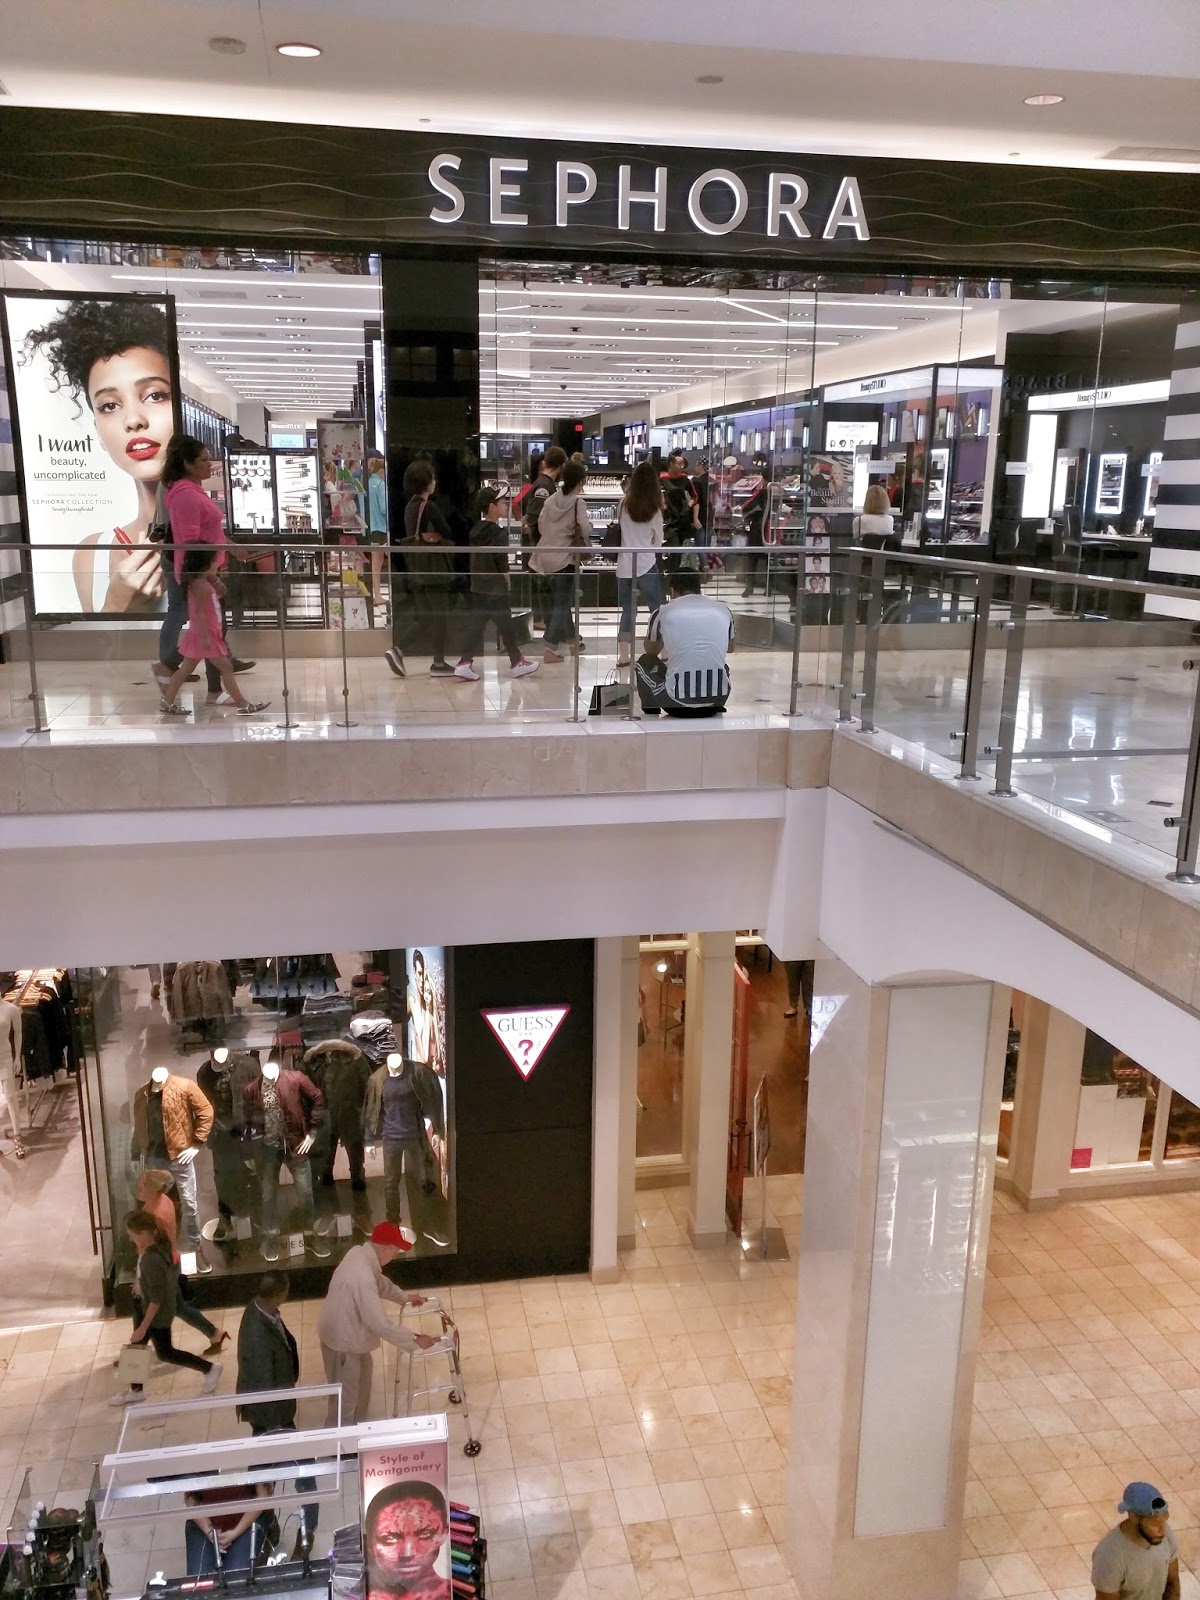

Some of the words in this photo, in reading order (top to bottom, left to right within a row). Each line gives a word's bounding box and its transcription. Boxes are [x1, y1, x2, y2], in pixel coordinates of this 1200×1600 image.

[428, 153, 870, 241] SEPHORA
[38, 434, 43, 452] I
[48, 434, 94, 452] want
[50, 456, 87, 468] beauty,
[33, 470, 106, 481] uncomplicated
[810, 489, 837, 498] Beauty
[820, 496, 848, 505] Studio
[498, 1015, 553, 1032] GUESS
[380, 1453, 409, 1466] Style
[413, 1451, 426, 1461] of
[365, 1463, 441, 1477] Montgomery
